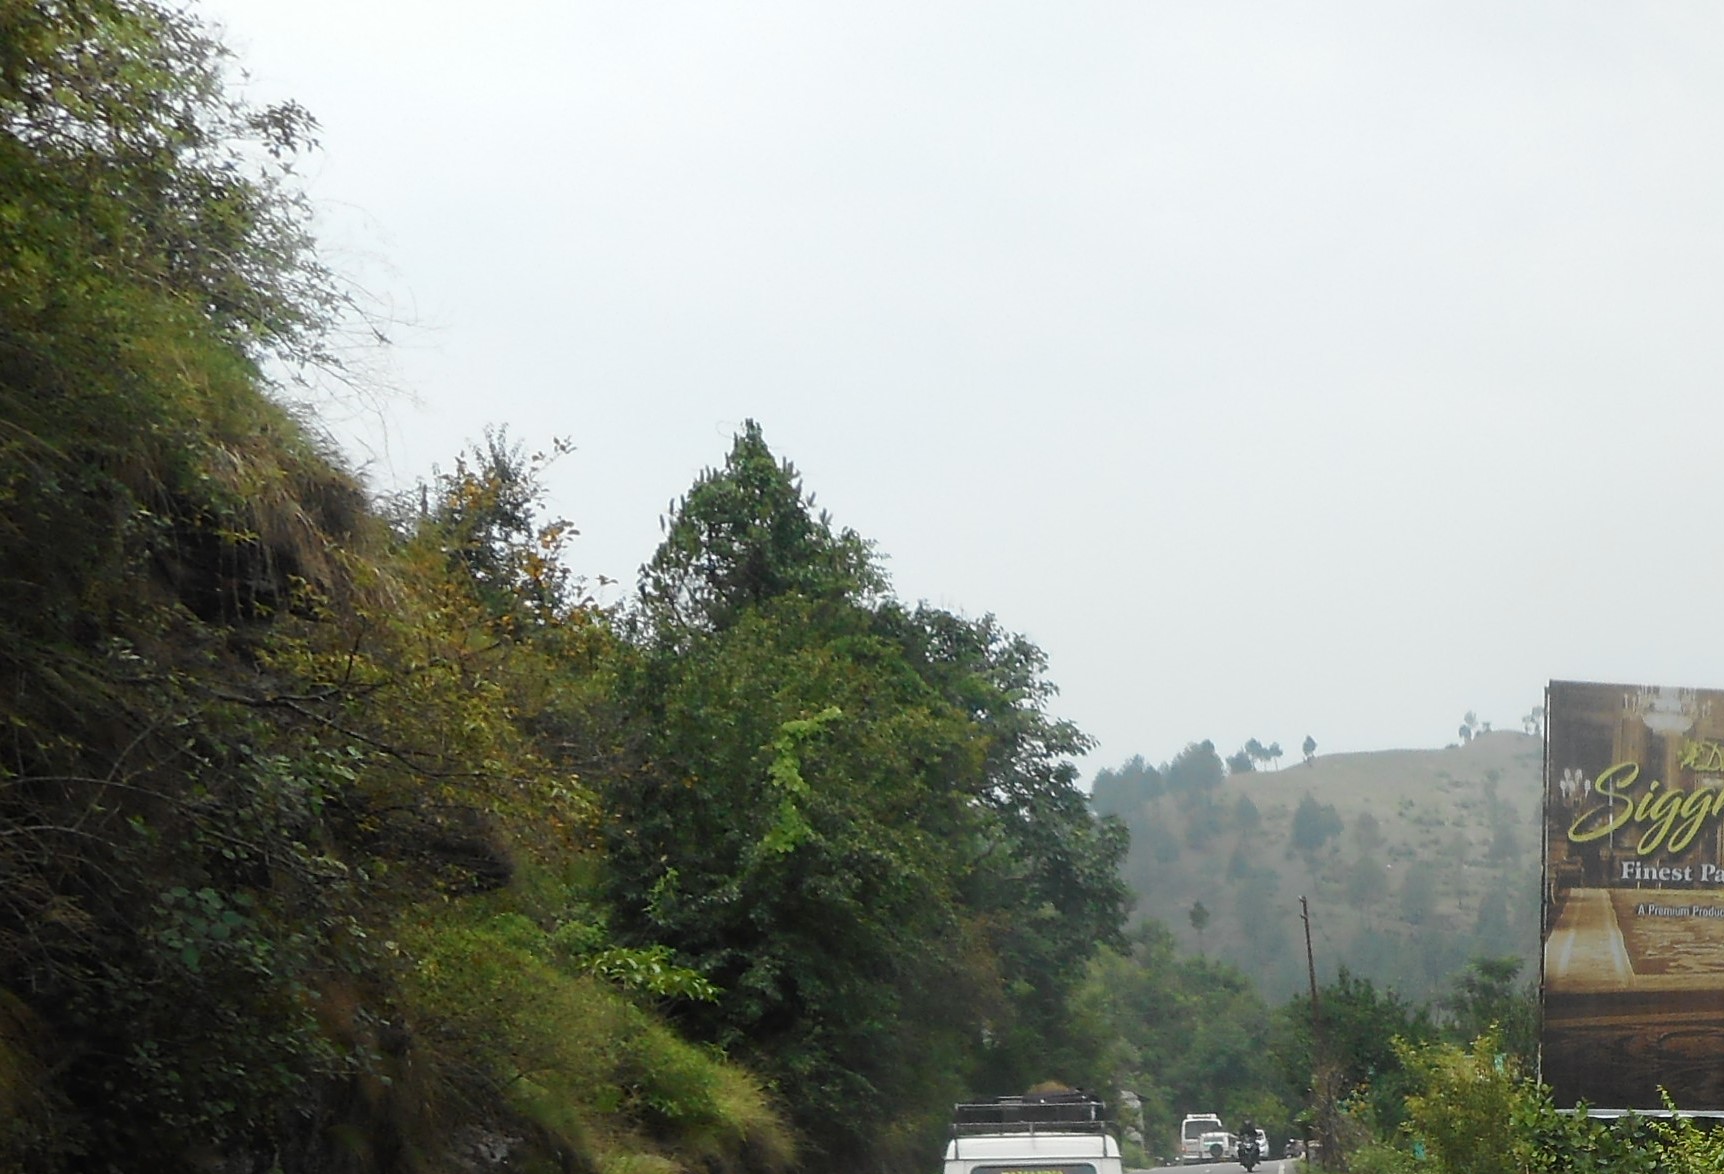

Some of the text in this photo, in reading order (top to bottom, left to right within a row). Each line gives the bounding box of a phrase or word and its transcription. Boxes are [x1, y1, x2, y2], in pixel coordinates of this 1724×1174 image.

[1620, 861, 1693, 883] Finest
[1637, 904, 1646, 916] A
[1648, 904, 1690, 919] Premium
